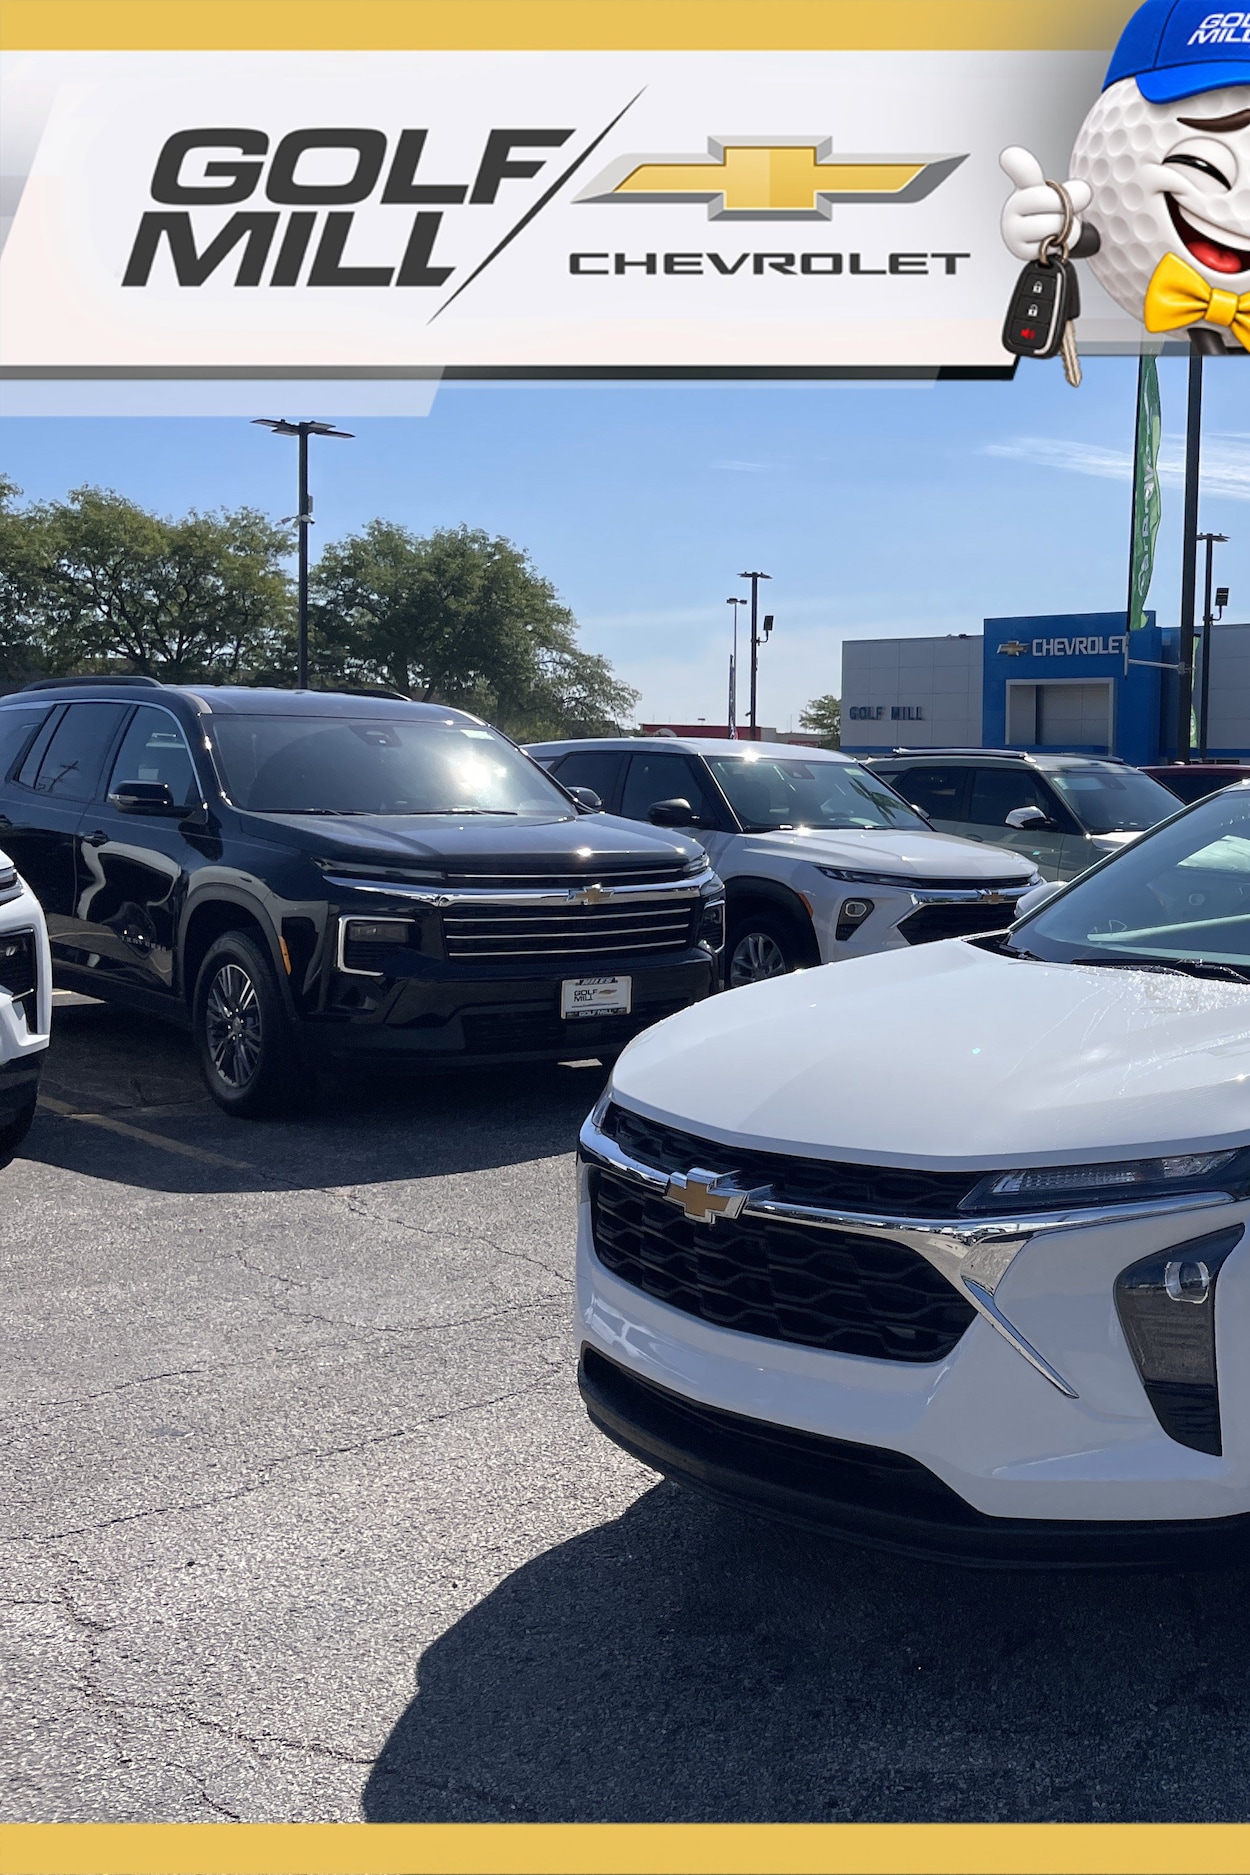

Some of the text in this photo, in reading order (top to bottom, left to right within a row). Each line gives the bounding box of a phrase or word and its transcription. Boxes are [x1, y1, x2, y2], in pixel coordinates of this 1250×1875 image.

[1032, 636, 1128, 656] CHEVROLET
[849, 706, 923, 721] GOLF MILL
[573, 994, 593, 1002] MILL
